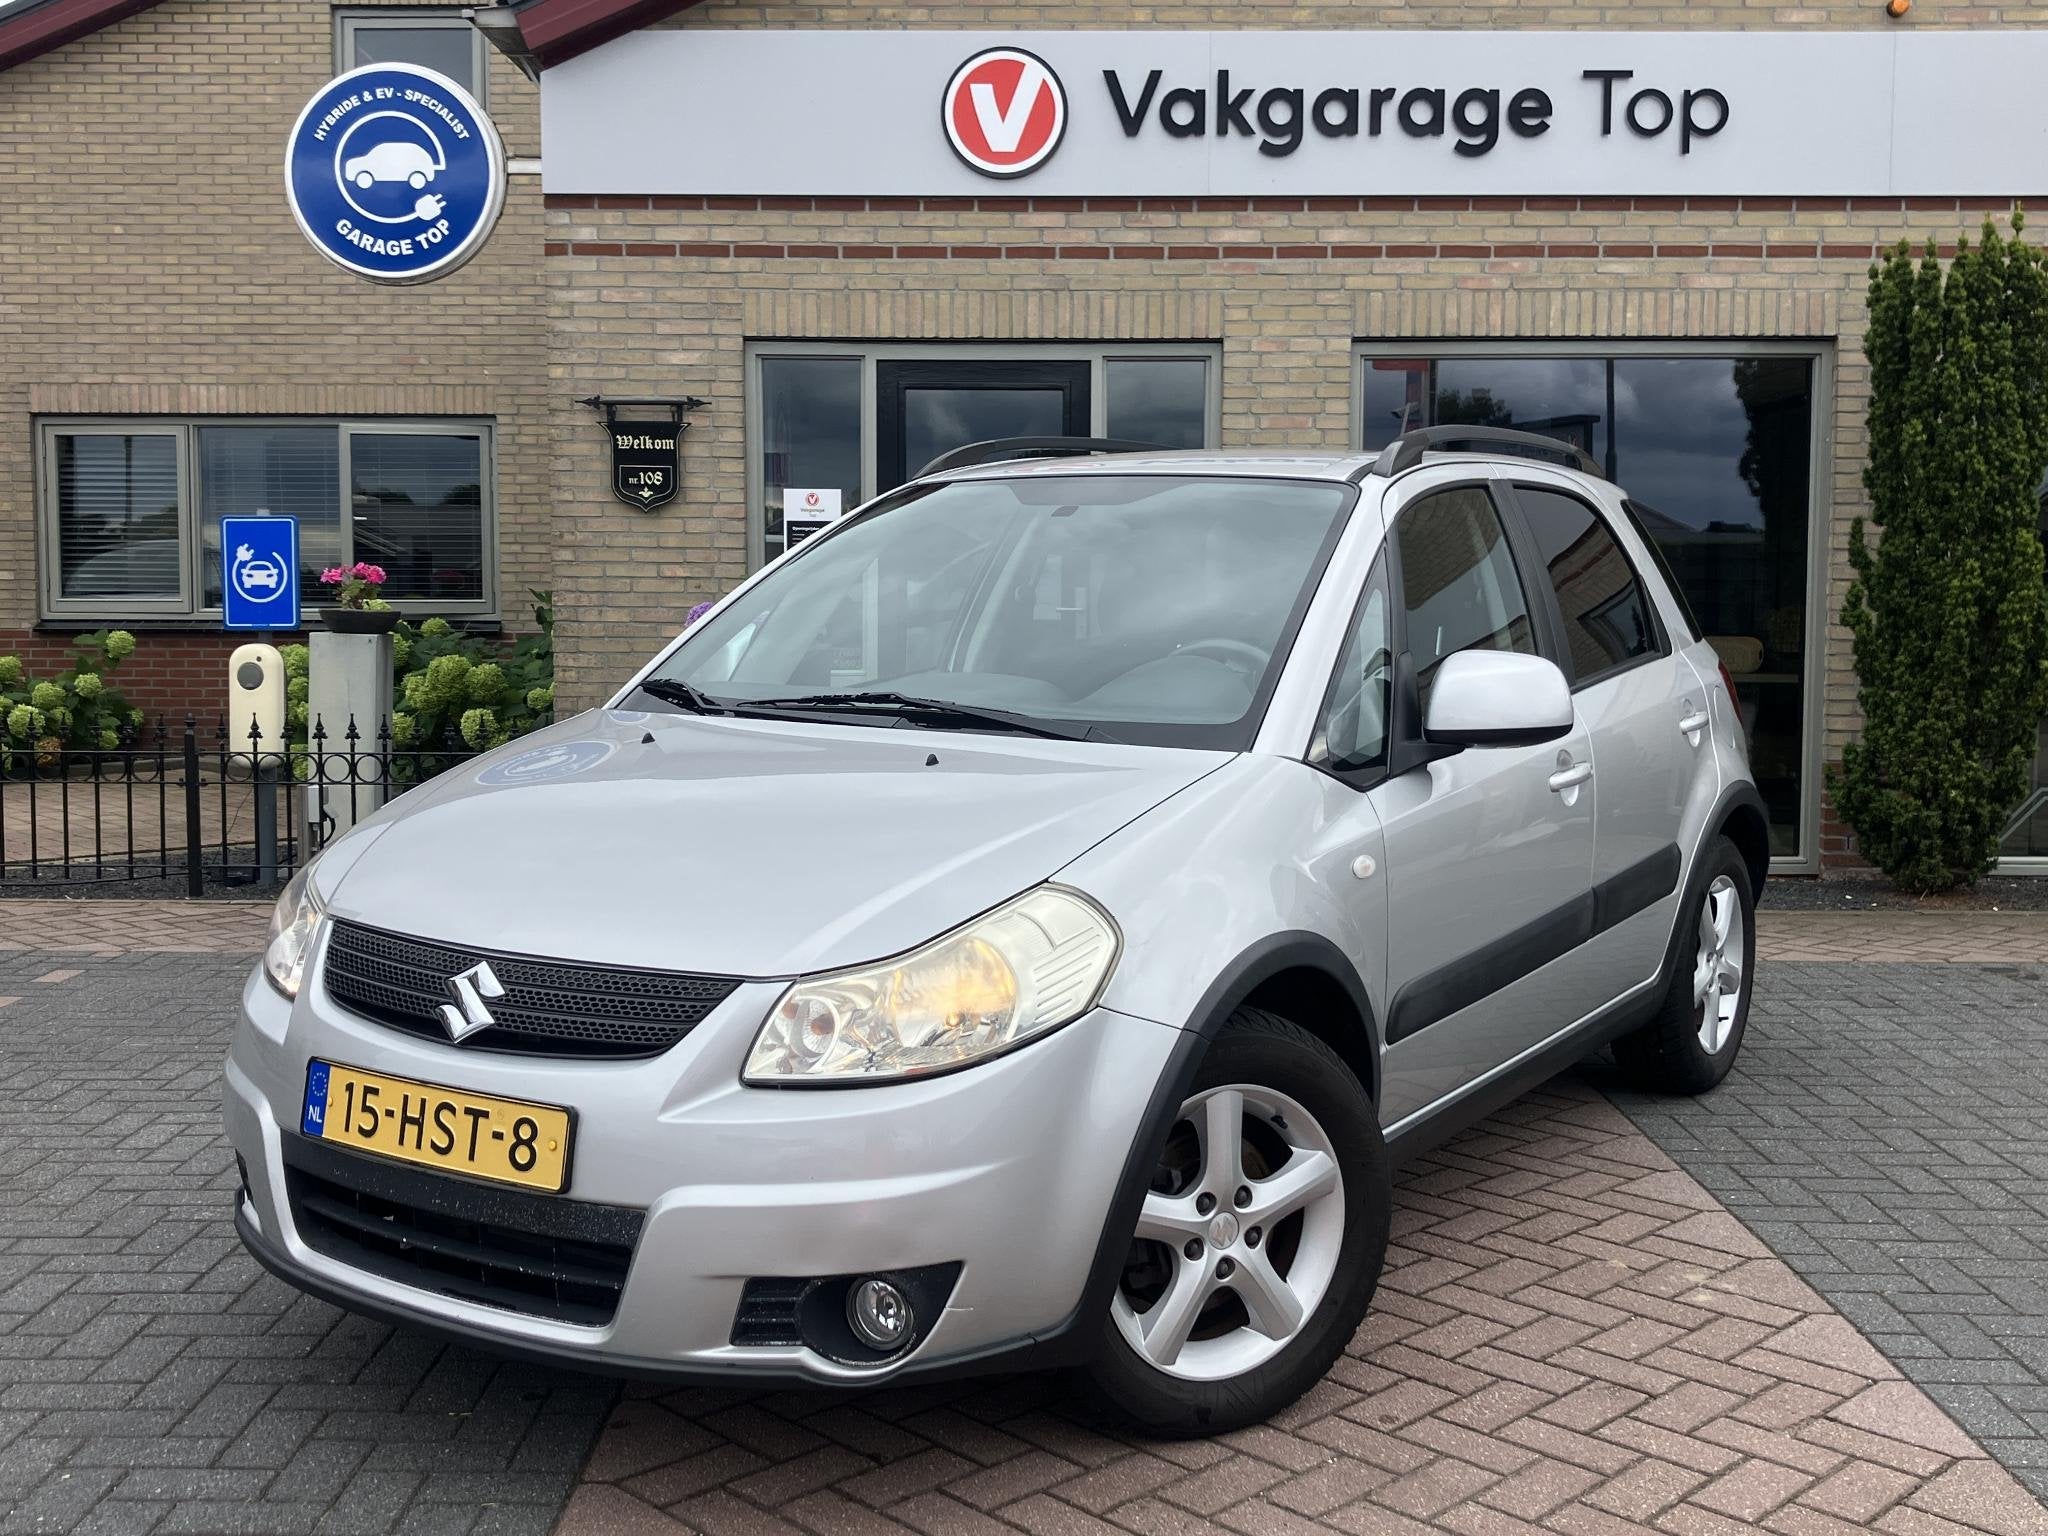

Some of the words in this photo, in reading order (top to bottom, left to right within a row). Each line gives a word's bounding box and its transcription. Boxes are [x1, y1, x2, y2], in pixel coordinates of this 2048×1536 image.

[313, 94, 361, 142] HYBRIDE
[362, 90, 374, 102] &
[375, 87, 394, 99] EV
[404, 89, 470, 140] SPECIALIST
[1102, 69, 1553, 158] Vakgarage
[1581, 69, 1730, 156] Top
[335, 218, 414, 257] GARAGE
[415, 218, 450, 250] TOP
[615, 434, 675, 450] Welkom
[639, 471, 663, 486] 108
[308, 1104, 323, 1124] NL
[343, 1080, 539, 1173] 15-HST-8
